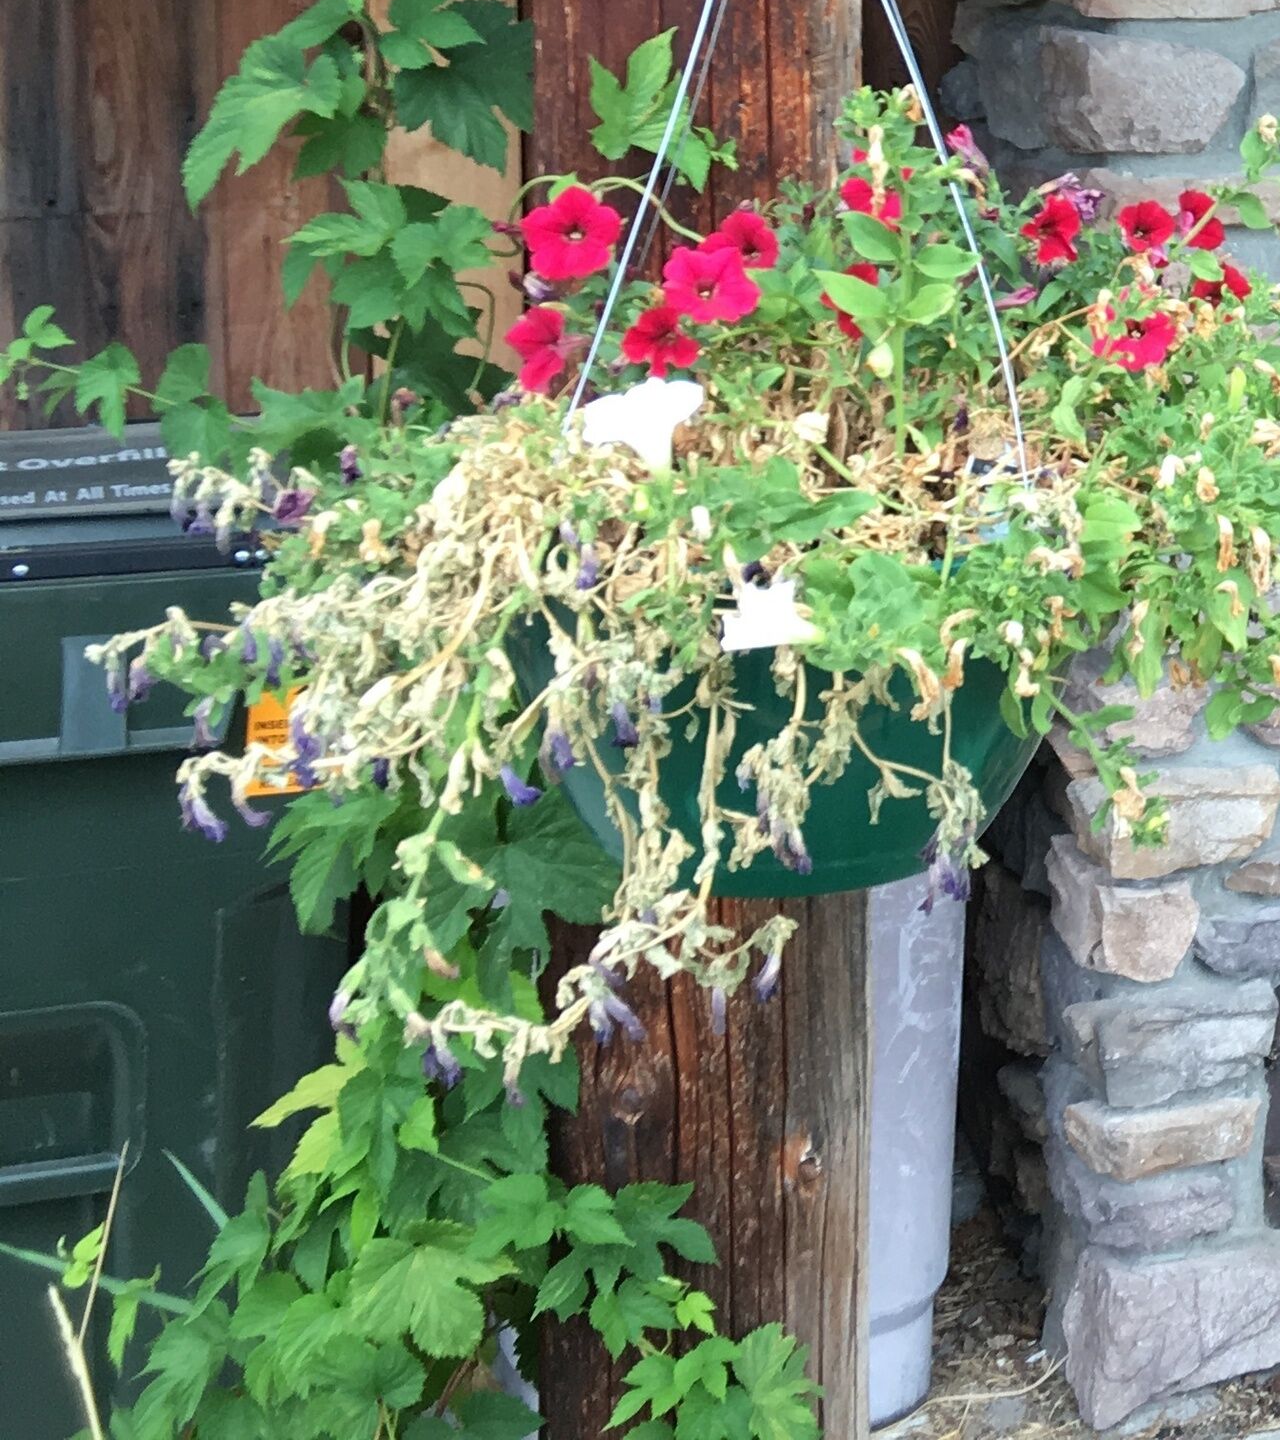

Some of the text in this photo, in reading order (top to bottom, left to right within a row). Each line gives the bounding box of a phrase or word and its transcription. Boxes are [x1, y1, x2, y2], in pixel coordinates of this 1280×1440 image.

[17, 447, 167, 470] Overfill
[44, 489, 68, 503] At
[75, 485, 105, 501] All
[109, 482, 172, 498] Times
